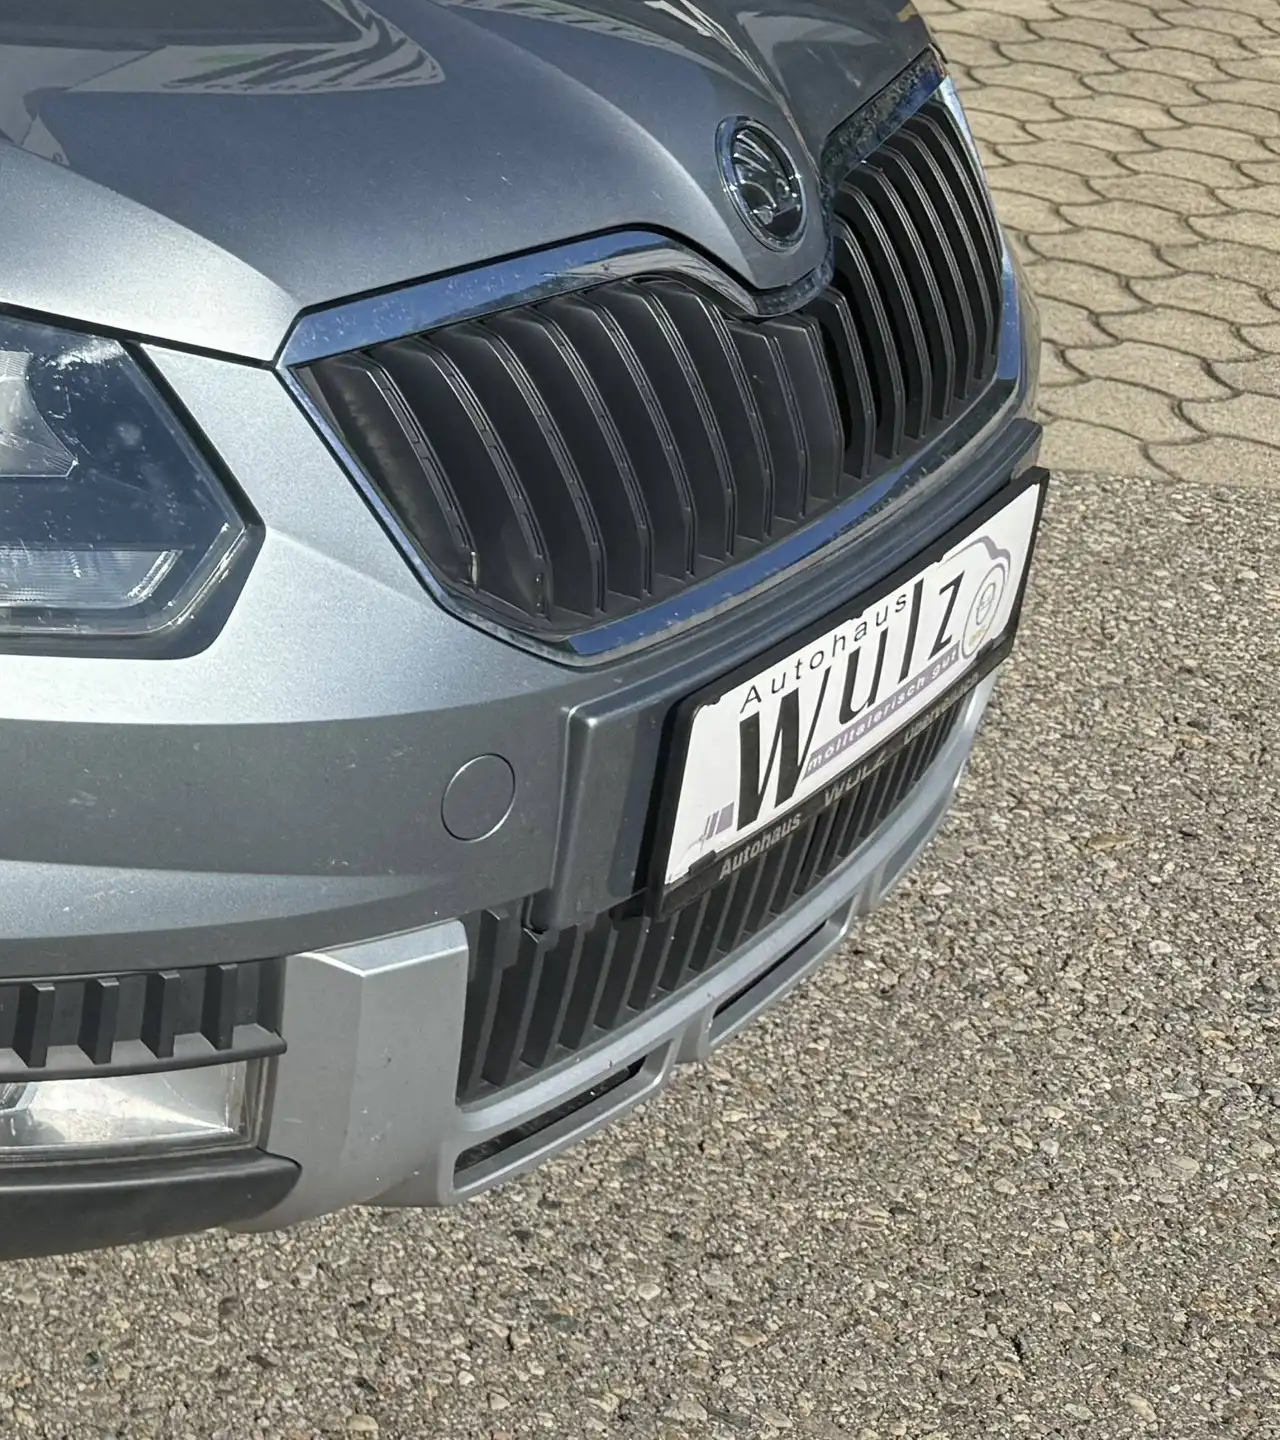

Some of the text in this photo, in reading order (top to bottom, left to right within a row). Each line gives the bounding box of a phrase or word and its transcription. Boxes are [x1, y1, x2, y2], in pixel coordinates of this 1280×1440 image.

[739, 593, 908, 713] Autohaus
[931, 650, 958, 680] gut
[719, 813, 802, 879] Autohaus
